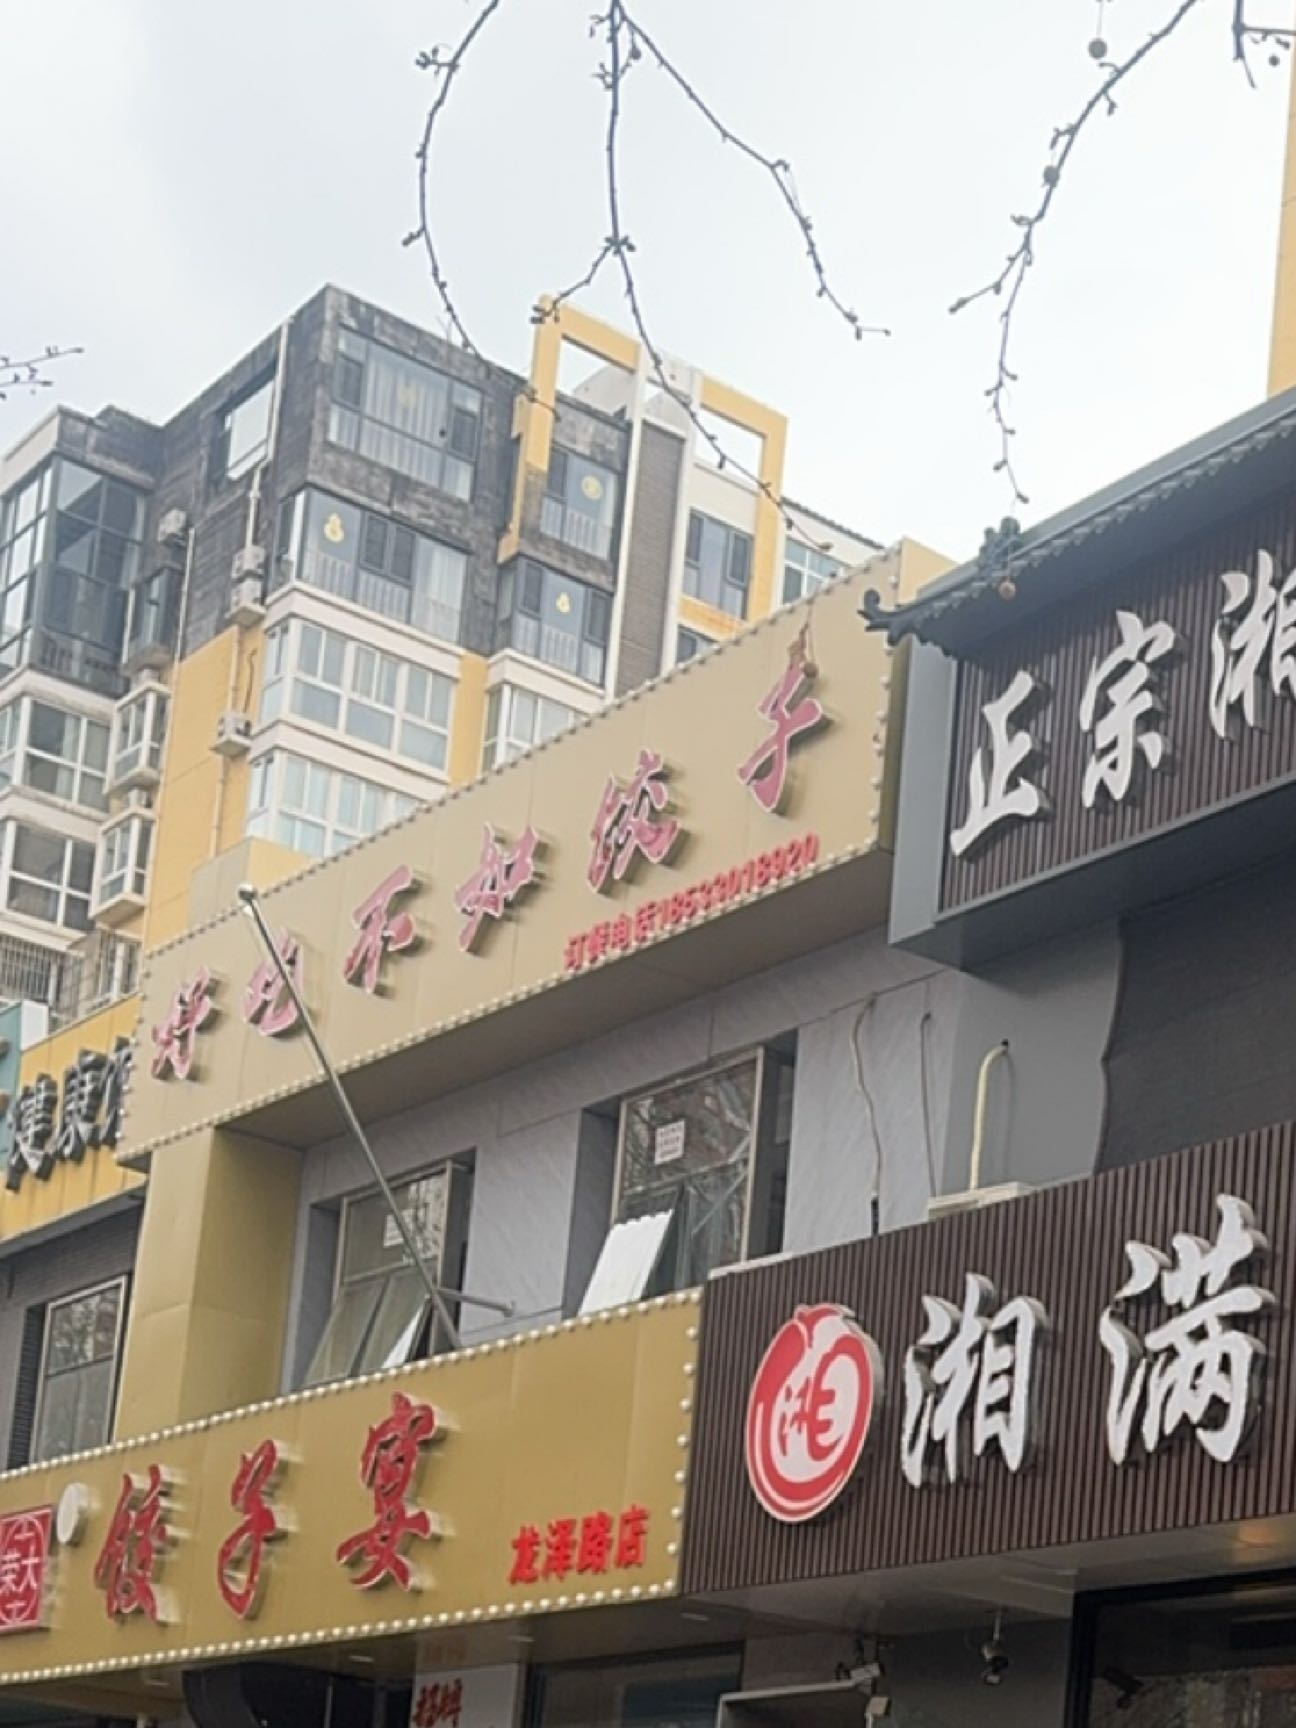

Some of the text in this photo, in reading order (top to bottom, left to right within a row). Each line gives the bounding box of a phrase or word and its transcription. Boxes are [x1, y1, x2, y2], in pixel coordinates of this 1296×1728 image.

[95, 1391, 438, 1620] 饺子宴
[507, 1504, 651, 1585] 龙泽路店
